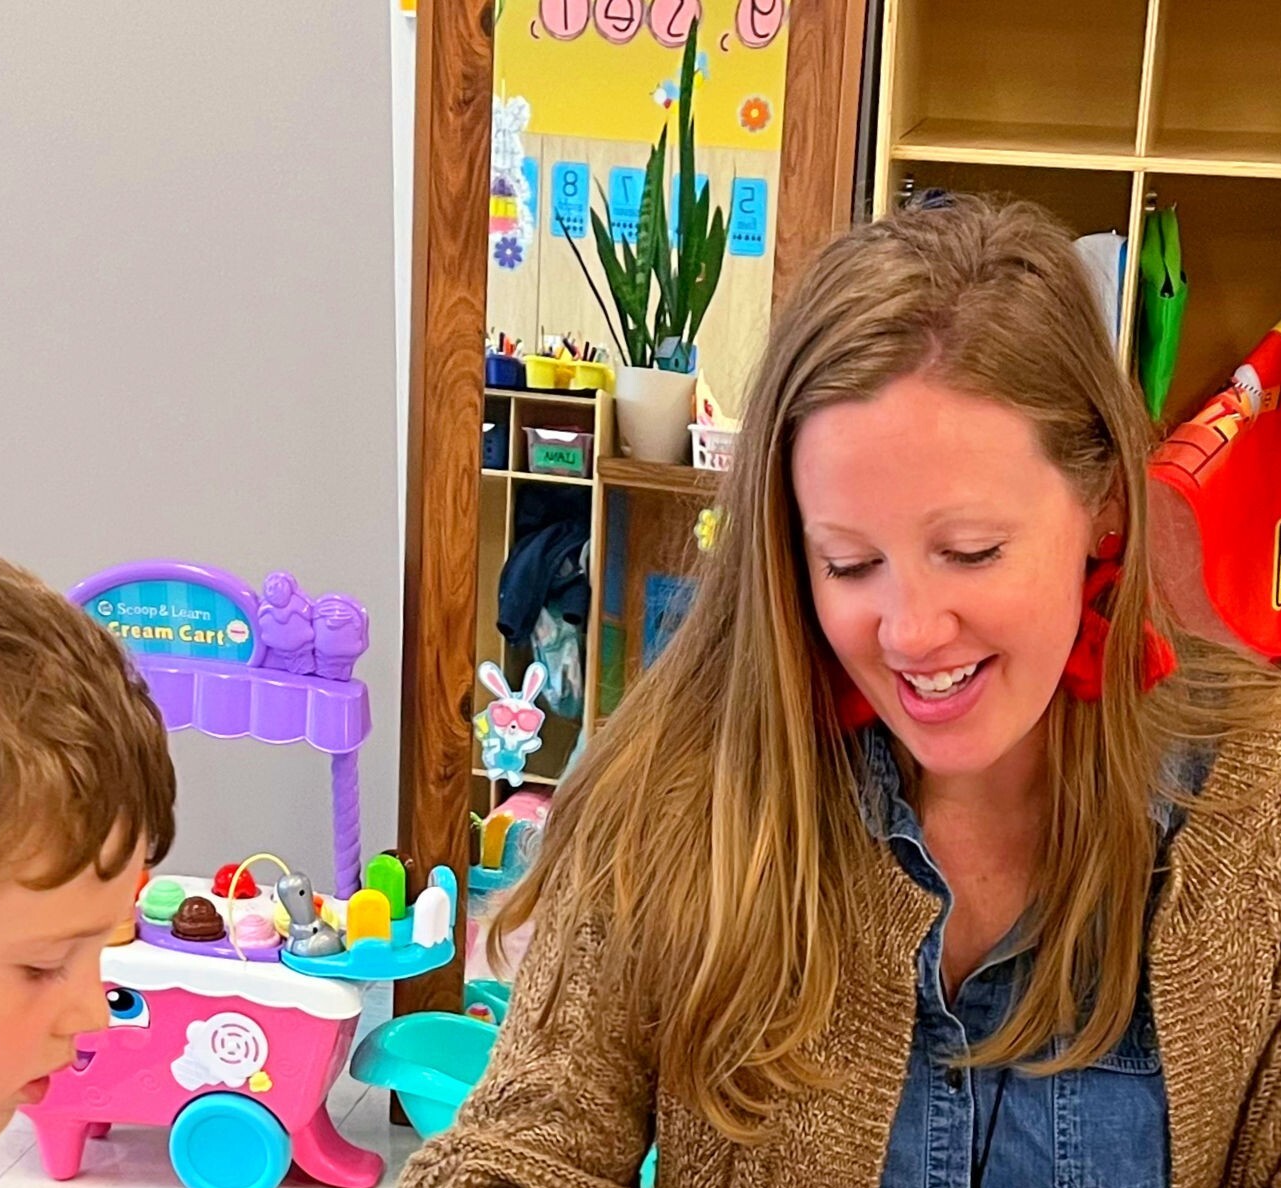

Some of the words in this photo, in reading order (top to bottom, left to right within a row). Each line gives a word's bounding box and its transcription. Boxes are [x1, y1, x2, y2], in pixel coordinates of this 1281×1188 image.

[117, 602, 158, 619] Scoop
[158, 604, 169, 617] &
[171, 604, 212, 621] Learn
[107, 620, 174, 641] Cream
[178, 624, 226, 645] Cart
